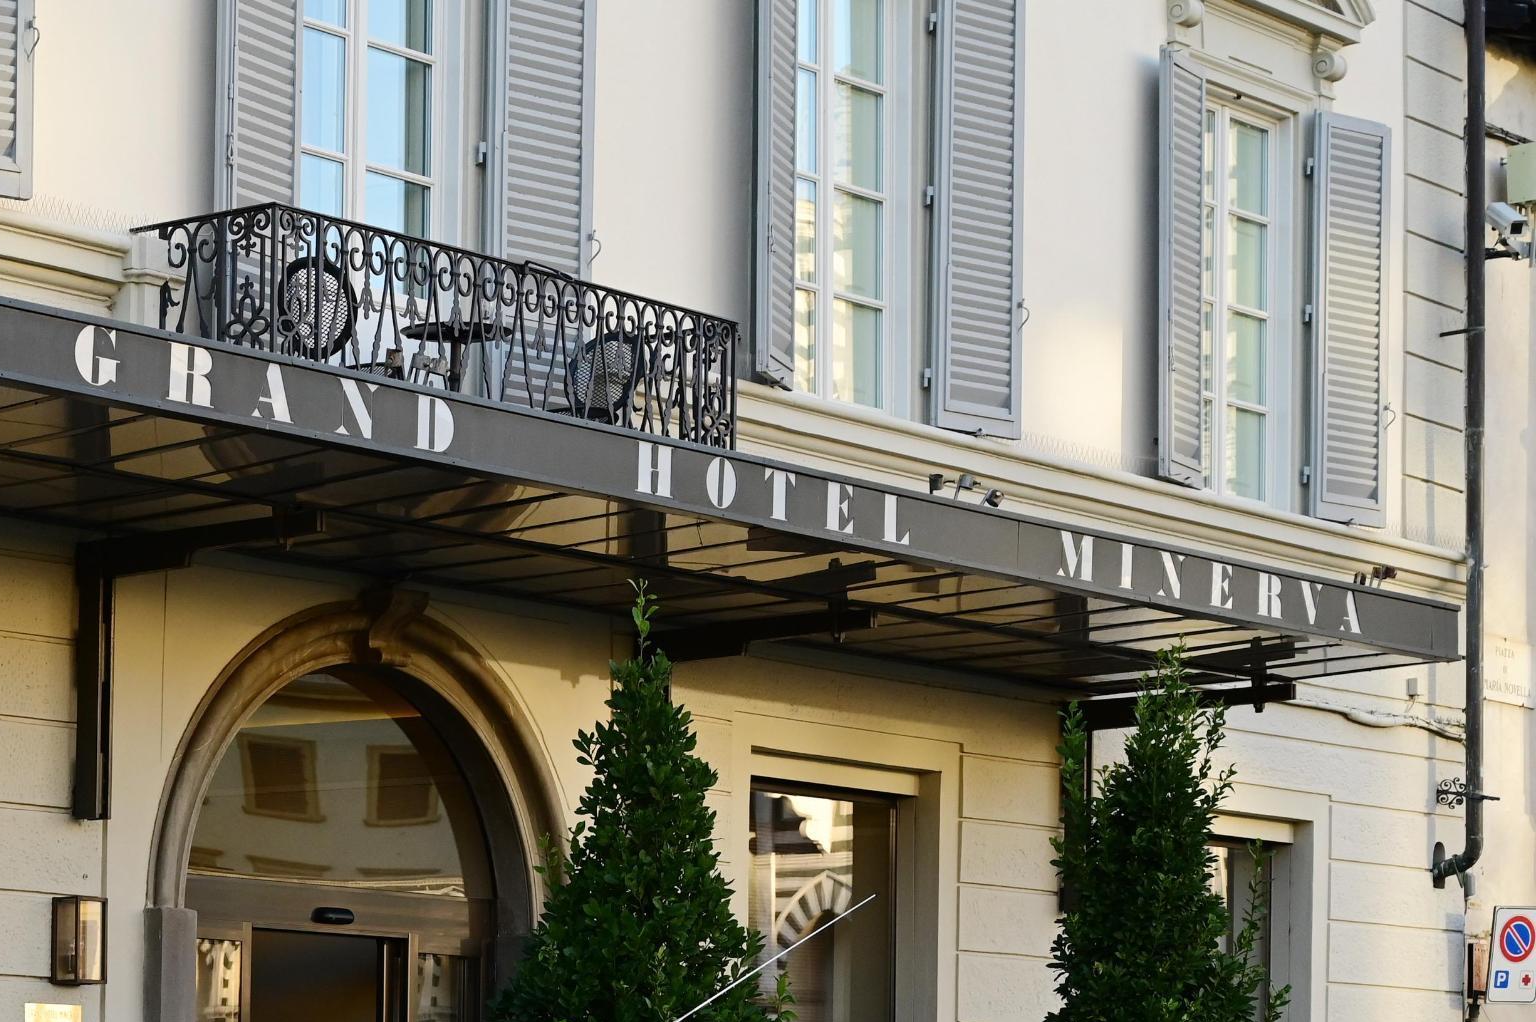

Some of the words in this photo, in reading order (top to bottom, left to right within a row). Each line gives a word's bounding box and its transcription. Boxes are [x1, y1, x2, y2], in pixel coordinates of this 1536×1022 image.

[73, 324, 455, 454] GRAND
[634, 440, 911, 546] HOTEL
[1055, 530, 1362, 634] MINERVA
[1497, 972, 1506, 987] P
